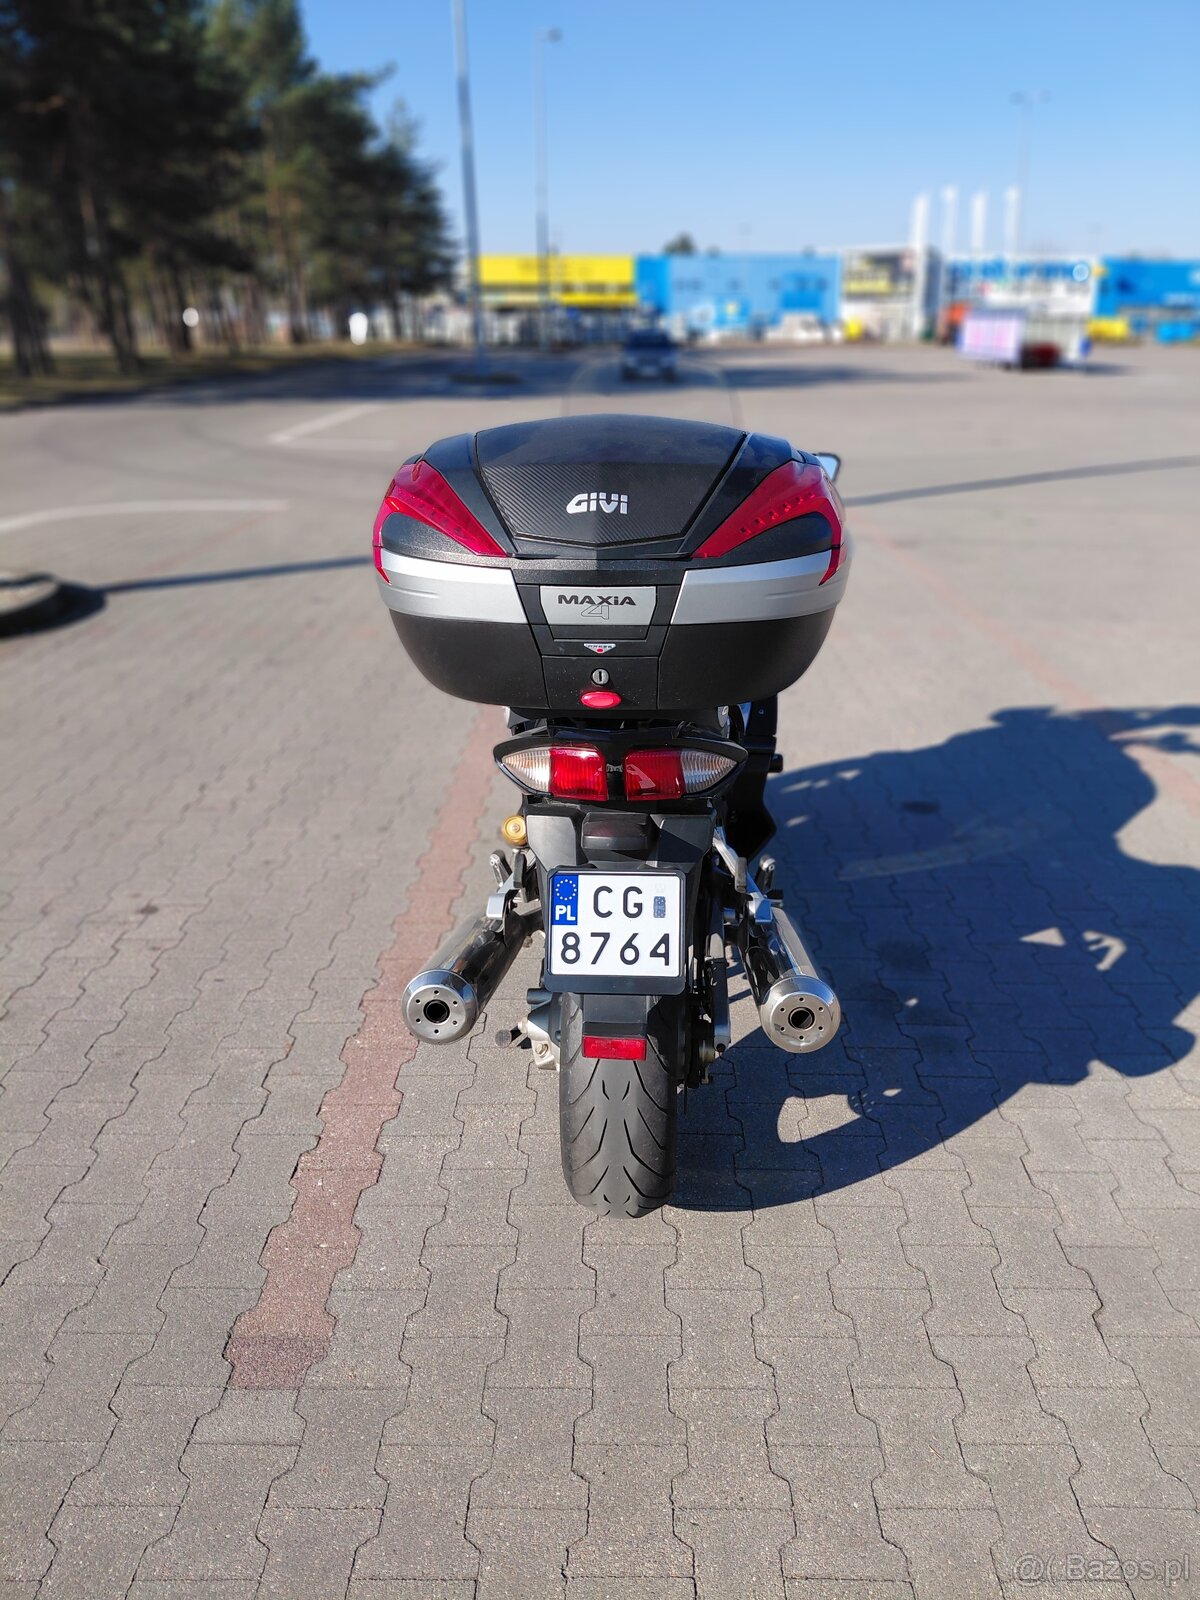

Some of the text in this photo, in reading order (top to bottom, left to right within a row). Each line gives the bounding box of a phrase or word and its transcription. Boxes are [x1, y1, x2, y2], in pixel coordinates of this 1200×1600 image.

[580, 604, 610, 620] 4
[555, 904, 576, 921] PL
[593, 885, 643, 919] CG
[560, 932, 670, 967] 8764
